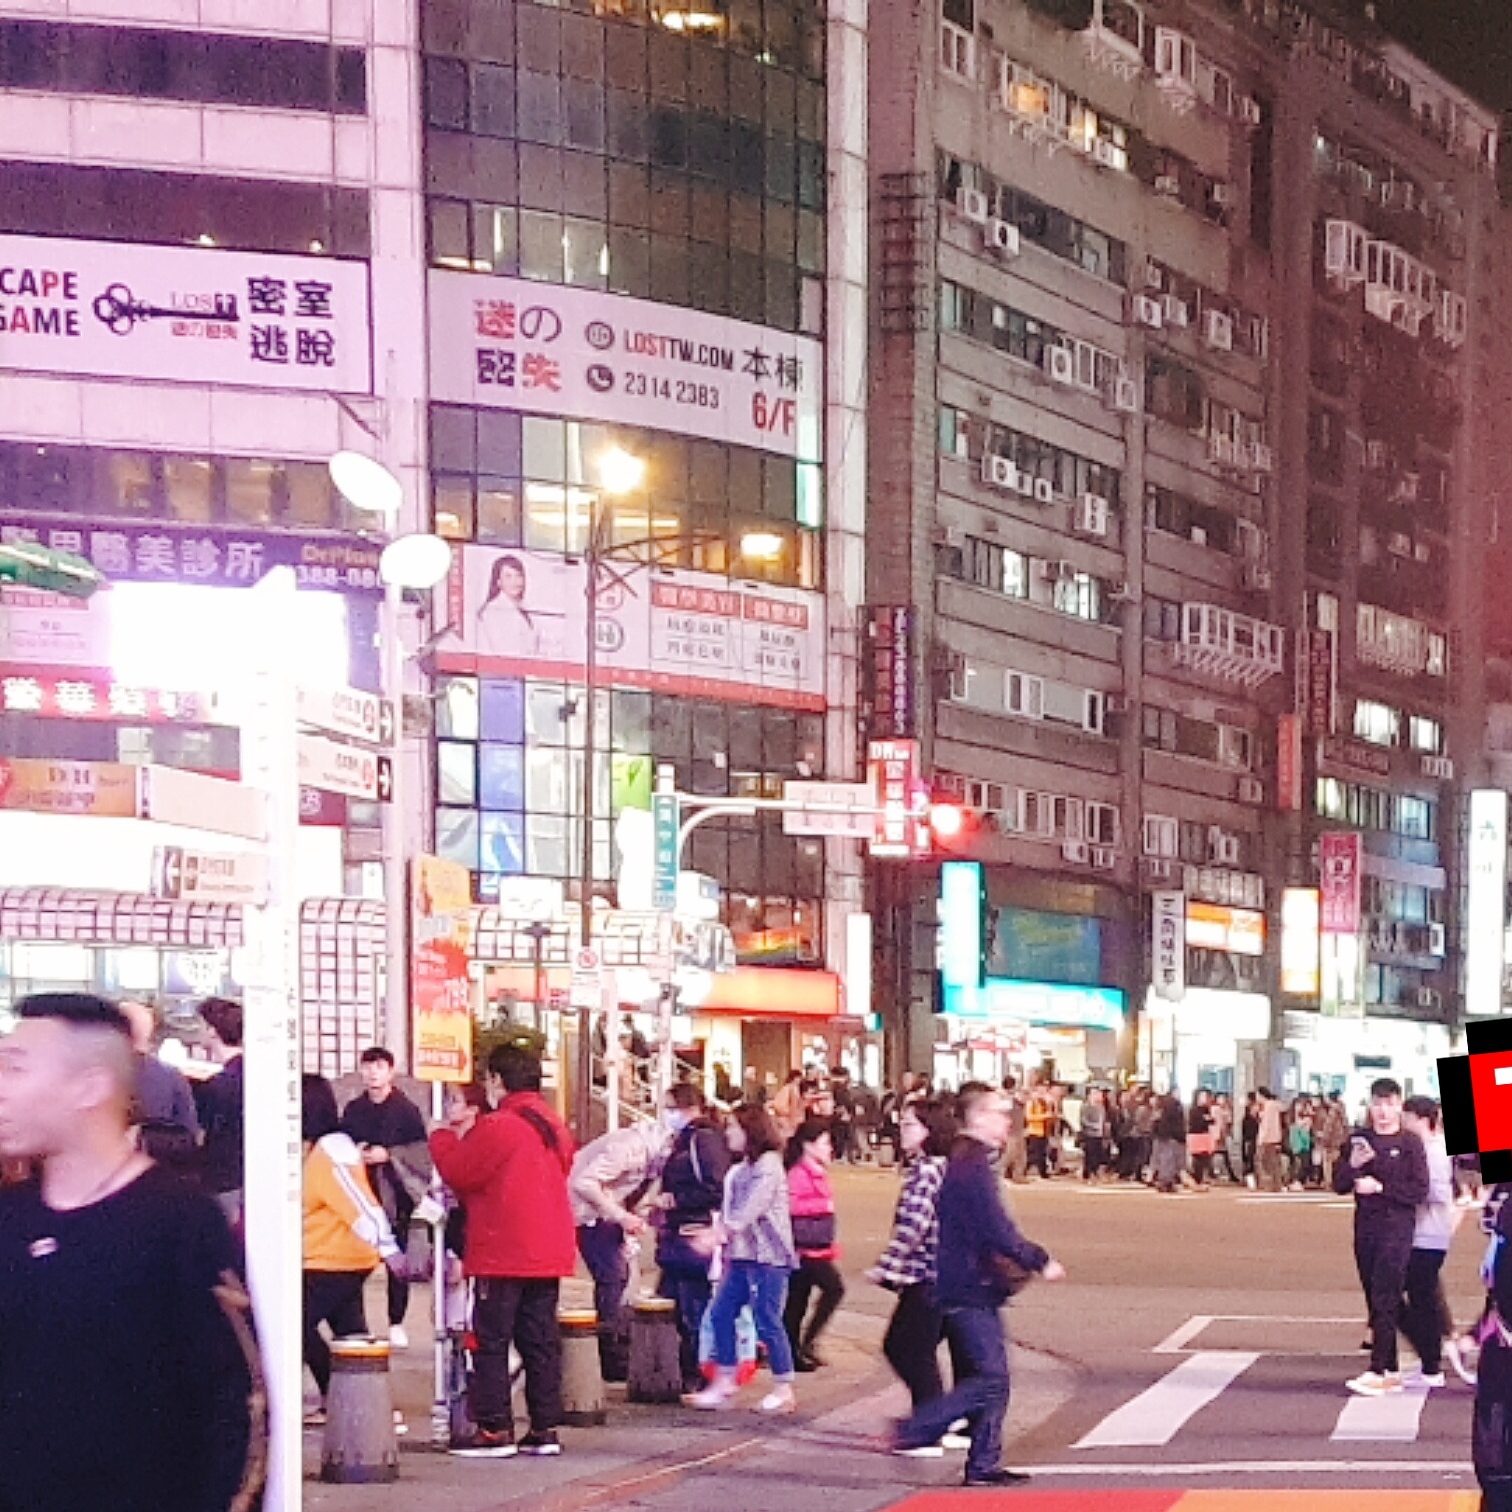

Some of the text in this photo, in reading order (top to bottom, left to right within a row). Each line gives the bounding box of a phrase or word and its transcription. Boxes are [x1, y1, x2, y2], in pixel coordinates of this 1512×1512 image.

[0, 267, 78, 299] CAPE
[247, 276, 333, 318] 密室
[624, 328, 733, 370] LOSTTW.COM
